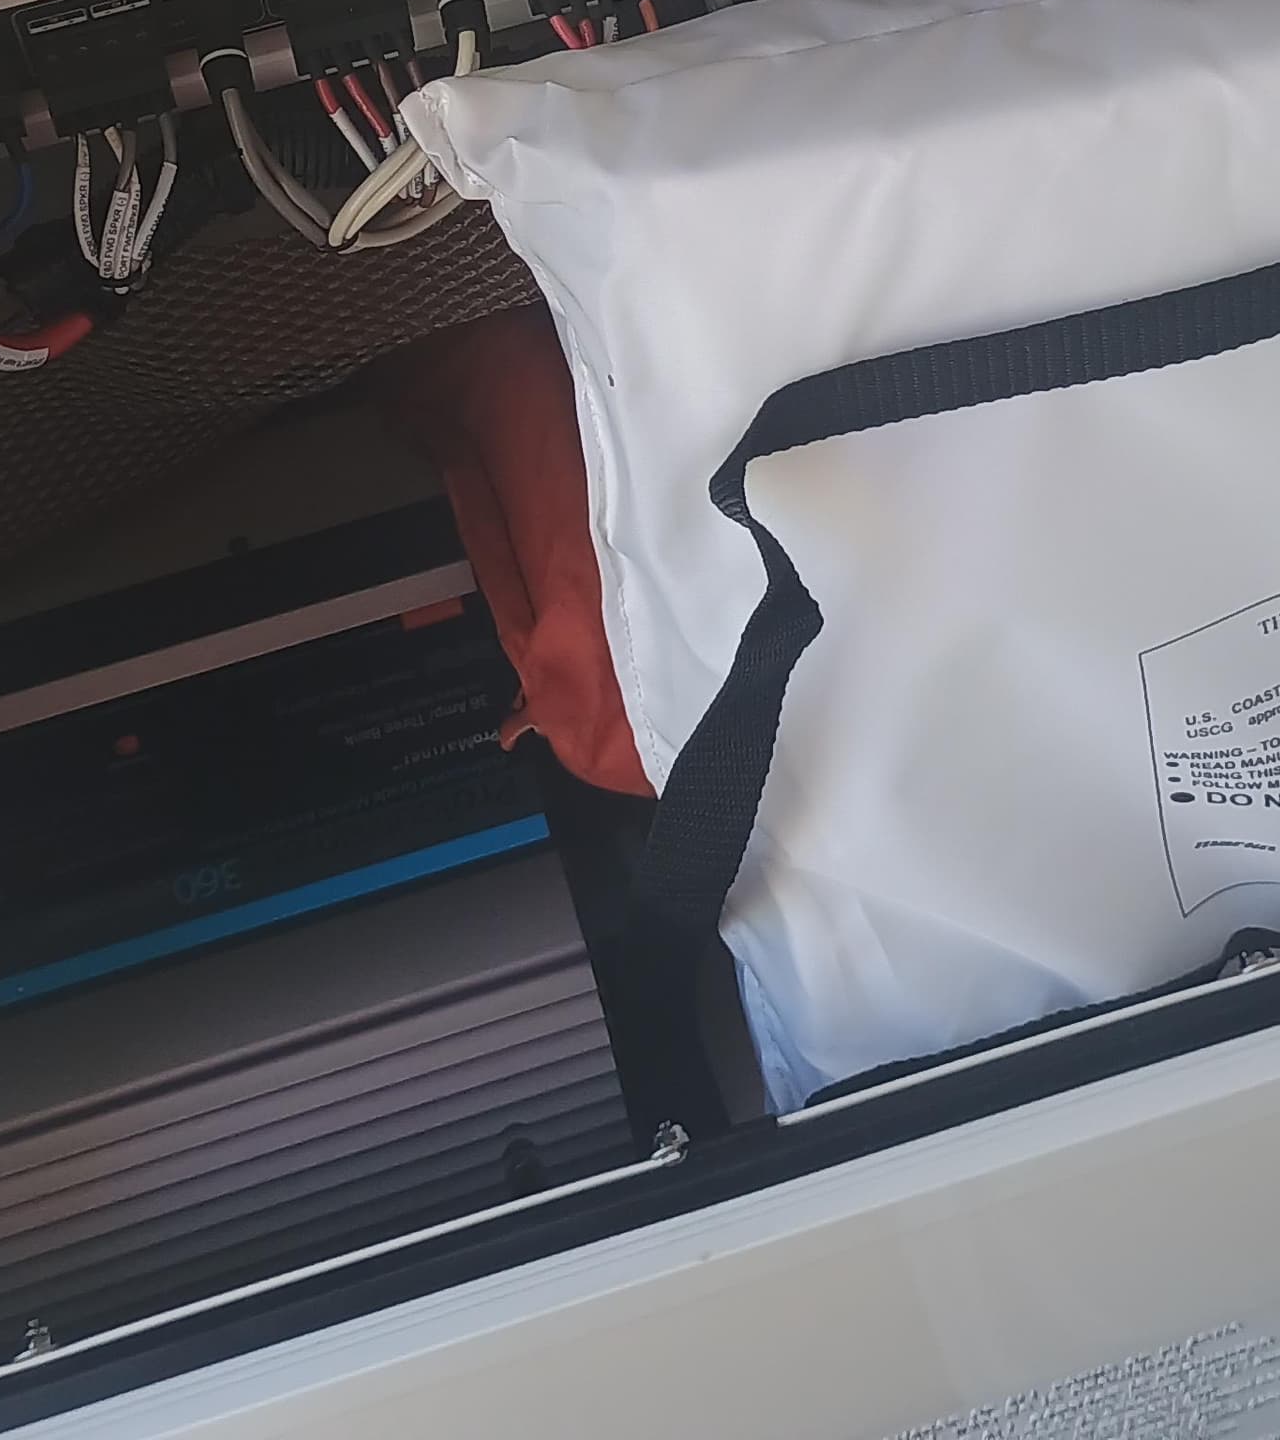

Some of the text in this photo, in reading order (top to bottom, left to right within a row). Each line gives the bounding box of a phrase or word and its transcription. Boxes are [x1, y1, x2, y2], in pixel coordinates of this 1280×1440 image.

[110, 209, 122, 235] SPKR
[1185, 712, 1217, 727] U.S.
[1186, 721, 1234, 740] USCG
[1164, 748, 1243, 760] WARNING
[1189, 758, 1236, 770] READ
[1190, 769, 1242, 780] USING
[1192, 780, 1262, 790] FOLLOW
[1206, 791, 1253, 806] DO
